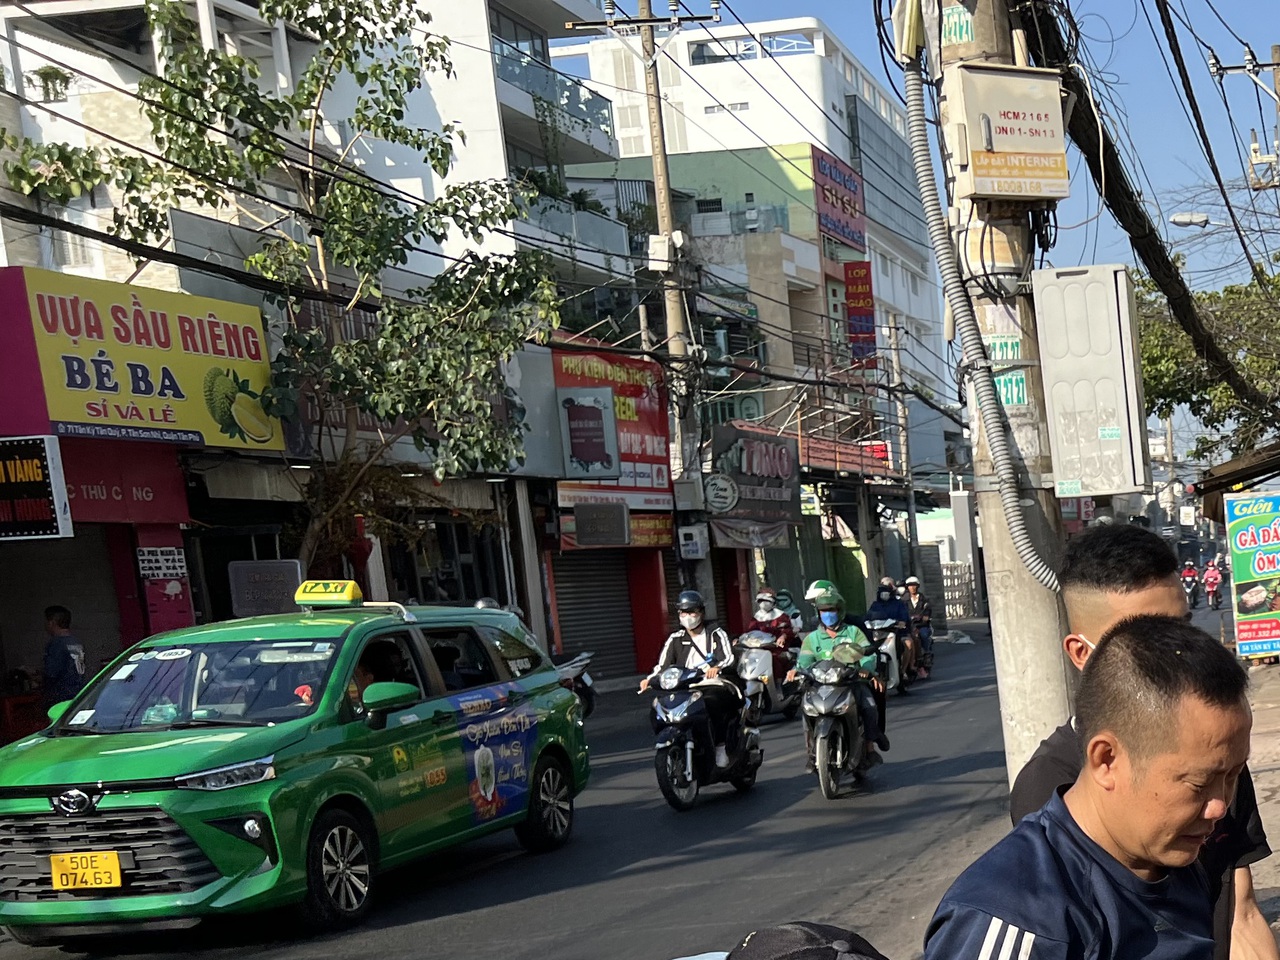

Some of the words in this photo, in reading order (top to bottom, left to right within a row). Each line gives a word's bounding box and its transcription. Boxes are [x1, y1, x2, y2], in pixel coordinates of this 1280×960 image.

[1006, 155, 1063, 168] INTERNET
[36, 293, 105, 346] VỰA
[110, 294, 172, 350] SẦU
[177, 312, 262, 363] RIÊNG
[126, 362, 187, 400] BA
[113, 401, 145, 421] VÀ
[6, 454, 43, 483] VÀNG
[81, 479, 107, 500] THÚ
[1237, 526, 1258, 547] GÀ
[302, 582, 348, 593] TAXI
[69, 855, 99, 870] 50E
[60, 871, 113, 887] 074.63
